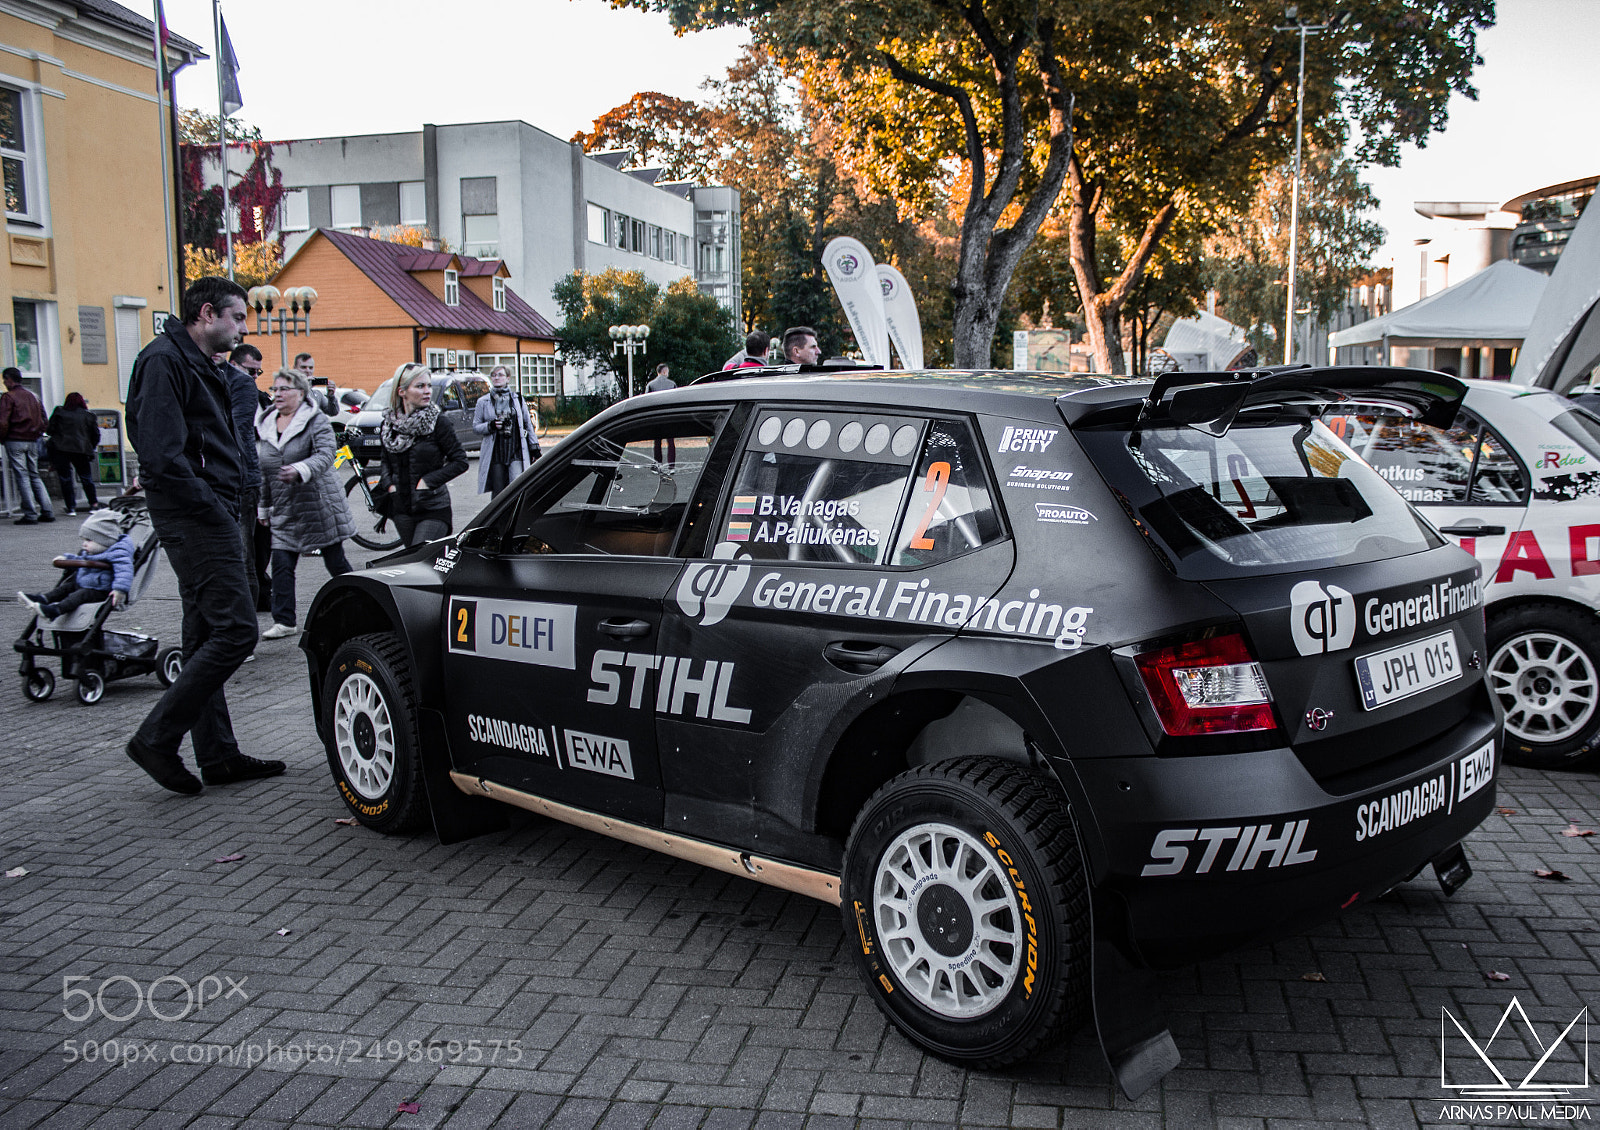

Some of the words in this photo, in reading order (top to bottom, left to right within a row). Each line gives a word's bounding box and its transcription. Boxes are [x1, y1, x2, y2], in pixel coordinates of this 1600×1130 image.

[1010, 439, 1052, 453] CITY
[1013, 428, 1058, 441] PRINT
[1006, 481, 1035, 489] BUSINESS
[1036, 483, 1070, 491] SOLUTIONS
[1009, 465, 1073, 480] Snap-on
[1372, 464, 1425, 481] otkus
[758, 495, 861, 521] B.Vanagas
[910, 461, 951, 550] 2
[1038, 509, 1089, 521] PROAUTO
[754, 522, 880, 546] A.Paliukėnas
[457, 608, 468, 643] 2
[491, 612, 554, 652] DELFI
[752, 572, 888, 618] General
[885, 578, 1094, 650] Financing
[1364, 583, 1440, 636] General
[587, 649, 752, 725] STIHL
[1382, 655, 1420, 695] JPH
[1424, 642, 1454, 678] 015
[1365, 689, 1375, 702] LT
[467, 713, 550, 757] SCANDAGRA
[571, 735, 628, 774] EWA
[1355, 774, 1446, 842] SCANDAGRA
[1465, 747, 1493, 792] EWA
[1140, 818, 1319, 877] STIHL
[982, 831, 1038, 997] SCORPION
